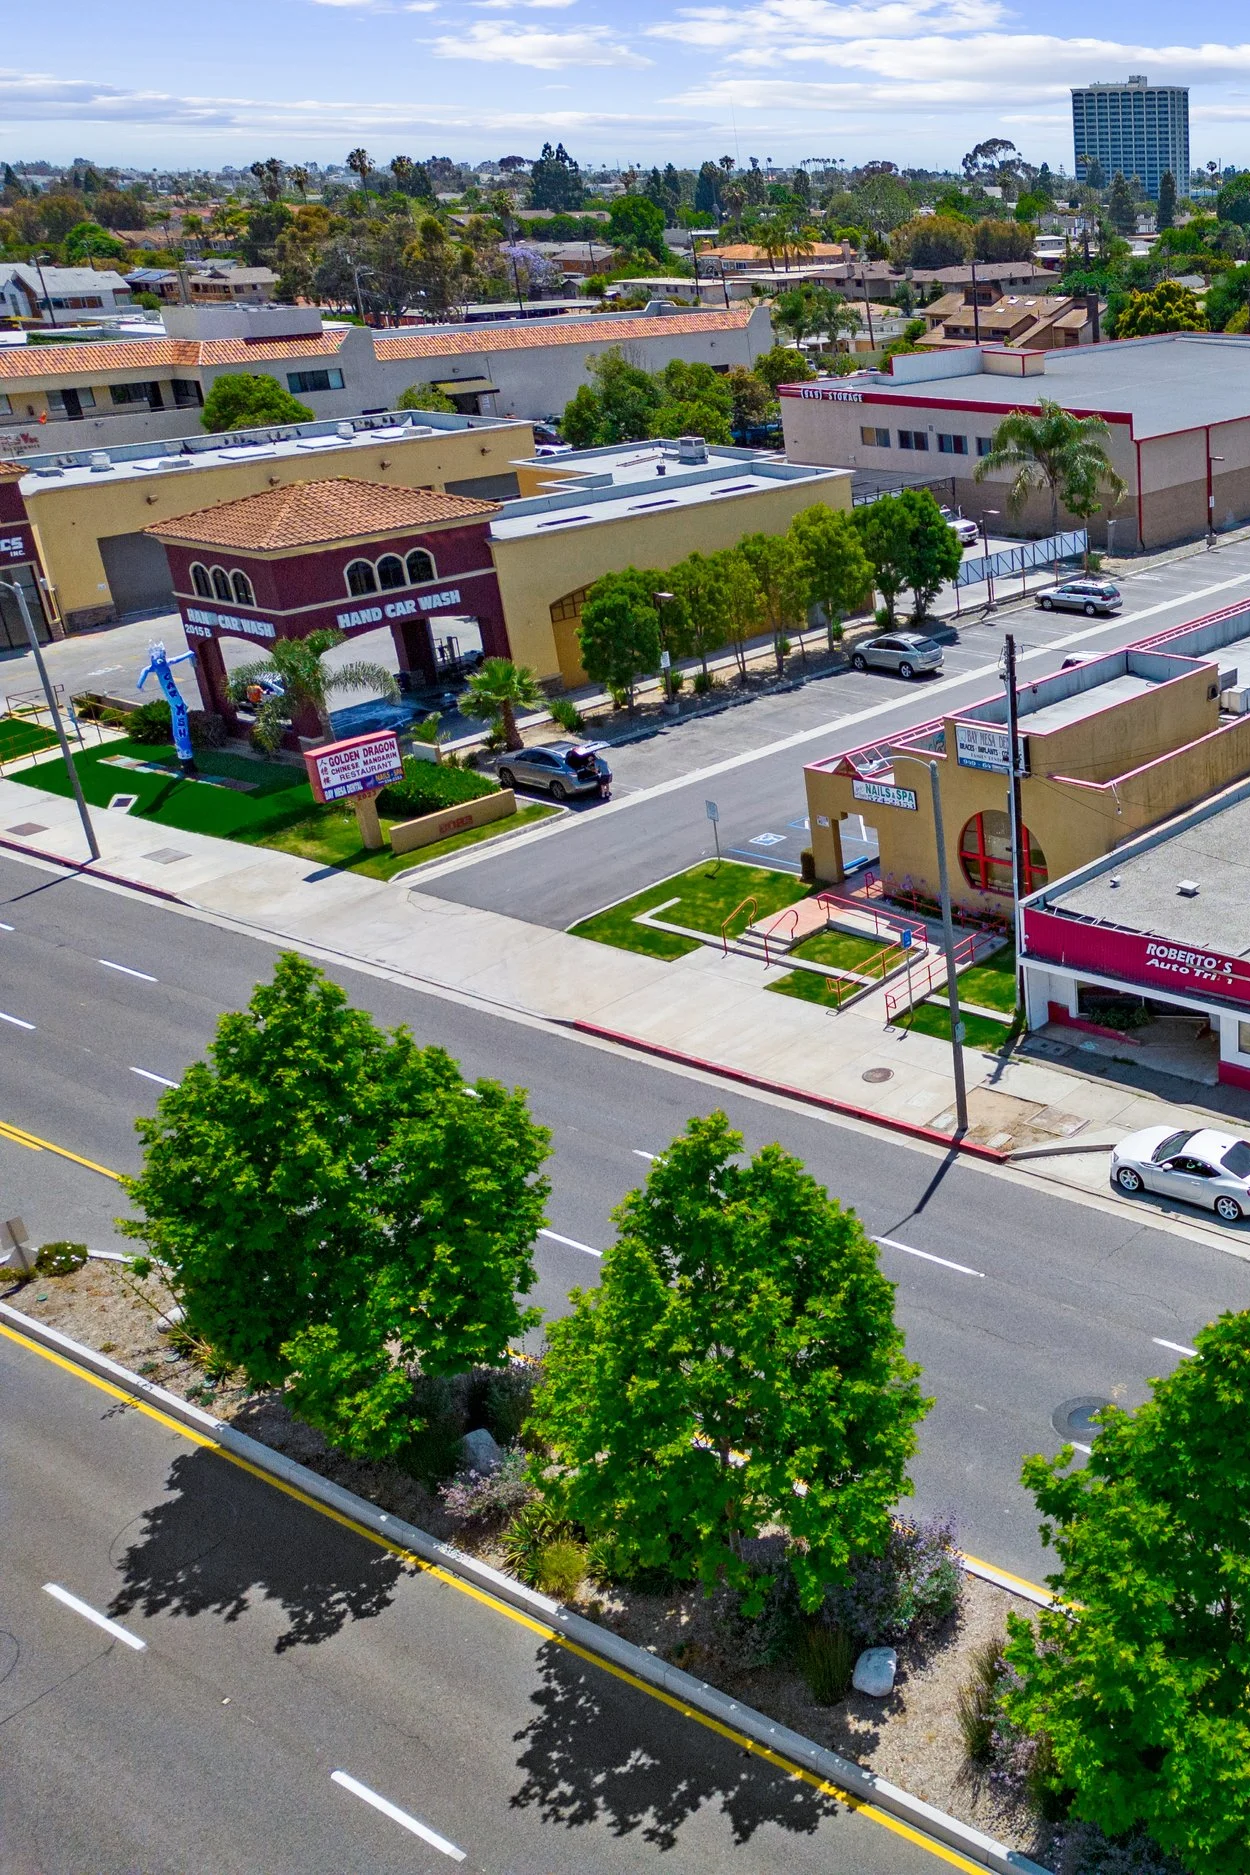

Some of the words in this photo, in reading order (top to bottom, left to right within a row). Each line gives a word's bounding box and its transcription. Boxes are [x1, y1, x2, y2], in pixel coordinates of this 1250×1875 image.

[828, 391, 863, 402] STORAGE
[337, 607, 382, 629] HAND
[384, 599, 417, 618] CAR
[417, 589, 461, 610] WASH
[184, 624, 204, 637] 2015
[217, 614, 243, 632] CAR
[240, 618, 276, 637] WASH
[328, 750, 360, 767] GOLDEN
[362, 740, 396, 757] DRAGON
[330, 761, 360, 776] CHINESE
[362, 752, 397, 766] MANDARIN
[339, 760, 393, 781] RESTAURANT
[865, 783, 891, 798] NAILS
[896, 789, 914, 803] SPA
[1145, 958, 1190, 974] Auto
